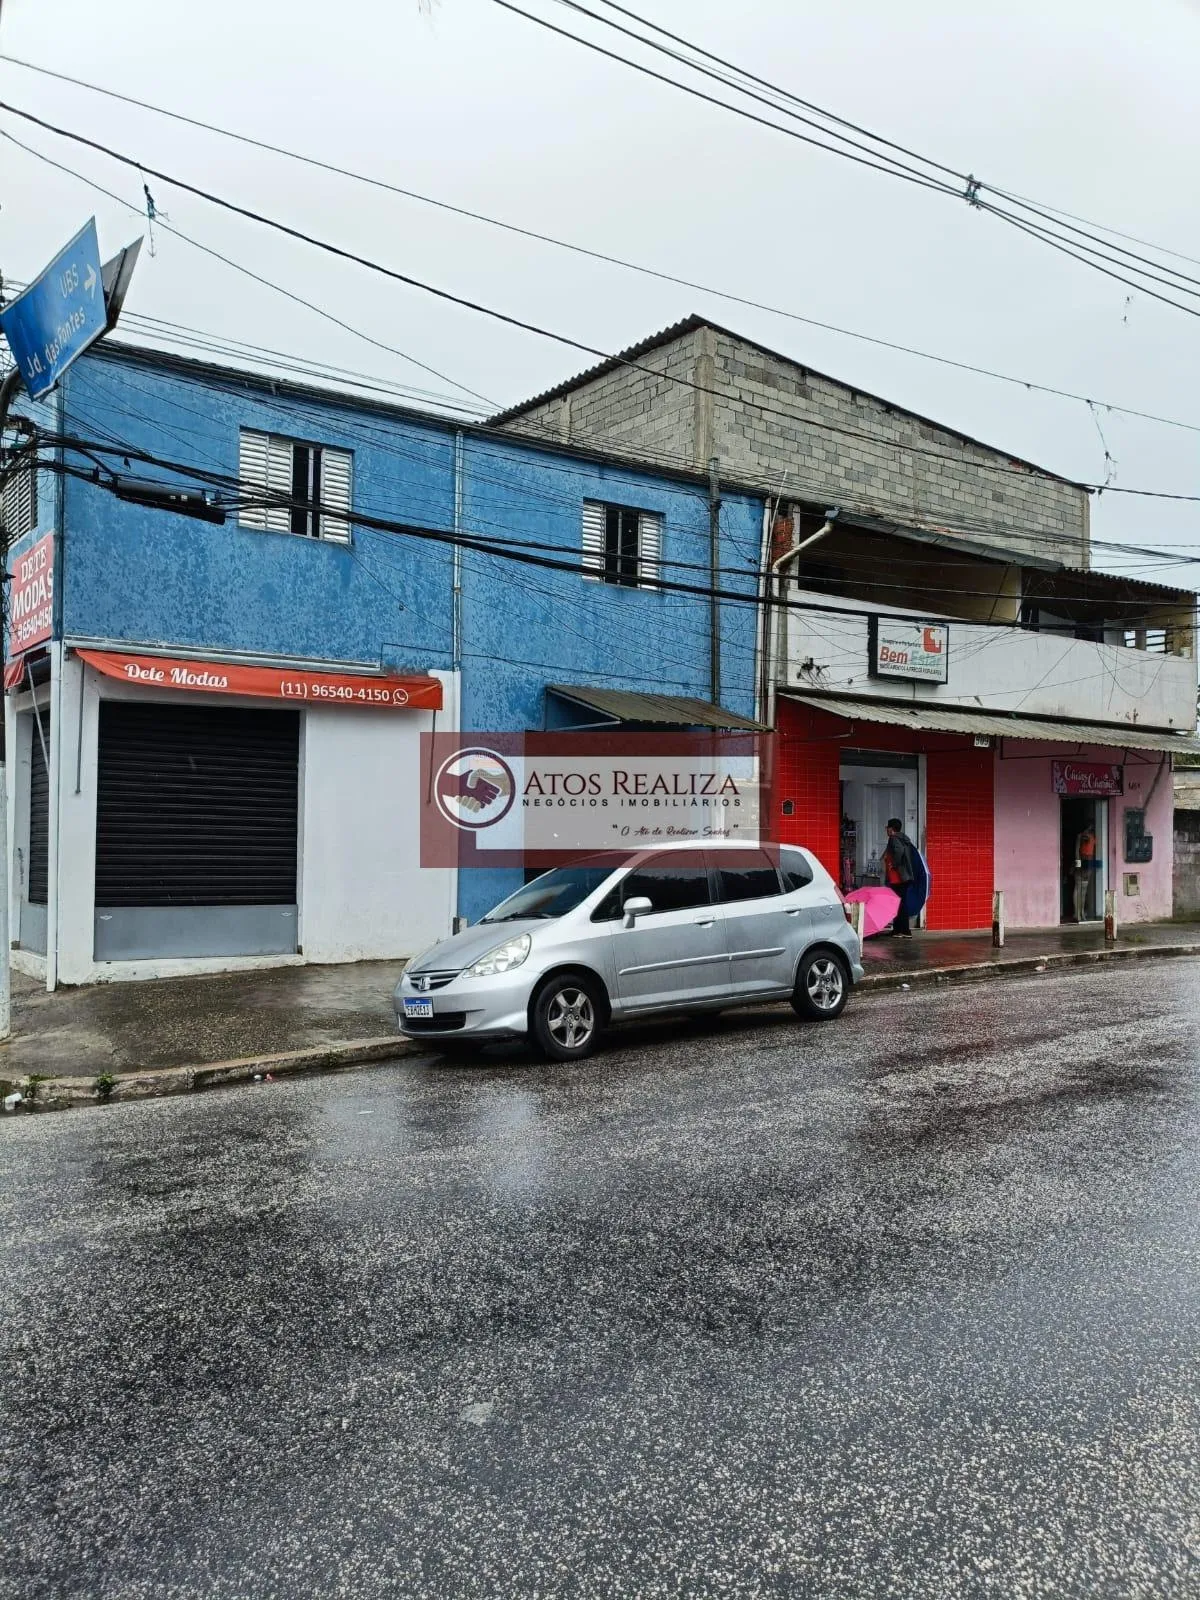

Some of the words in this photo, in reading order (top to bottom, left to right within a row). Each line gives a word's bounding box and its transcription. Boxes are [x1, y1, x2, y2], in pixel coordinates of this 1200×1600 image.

[60, 264, 79, 298] UBS
[27, 353, 47, 379] Jd.
[45, 340, 60, 365] das
[21, 545, 47, 584] DETE
[13, 567, 54, 621] MODAS
[880, 646, 908, 665] Bem
[124, 663, 165, 682] Dete
[170, 667, 228, 688] Modas
[280, 681, 308, 698] (11)
[311, 684, 390, 701] 96540-4150
